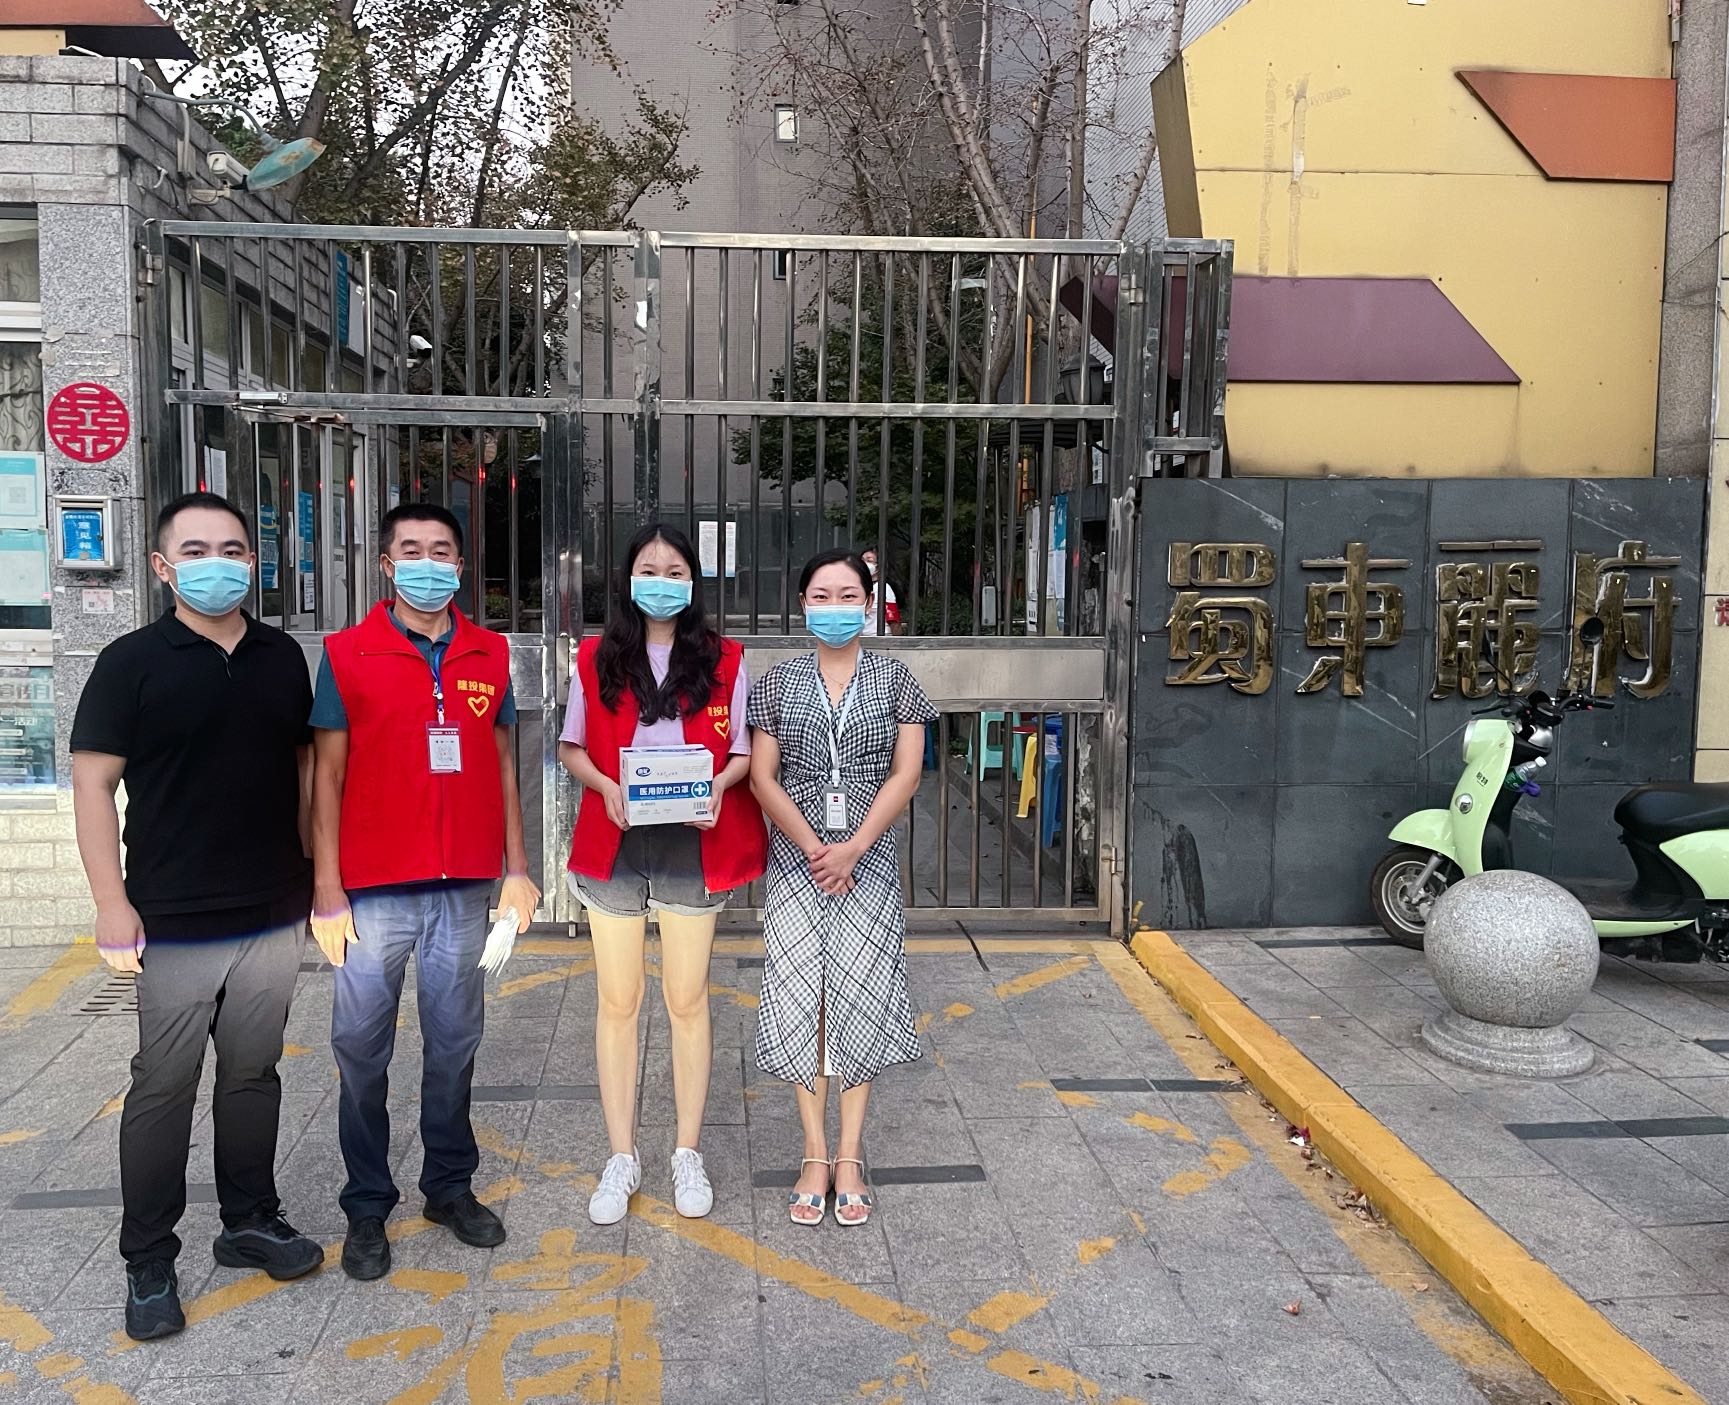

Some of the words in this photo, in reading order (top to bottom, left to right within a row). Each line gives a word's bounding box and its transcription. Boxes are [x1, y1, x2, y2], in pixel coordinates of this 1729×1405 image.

[639, 785, 690, 796] 医用防护口罩
